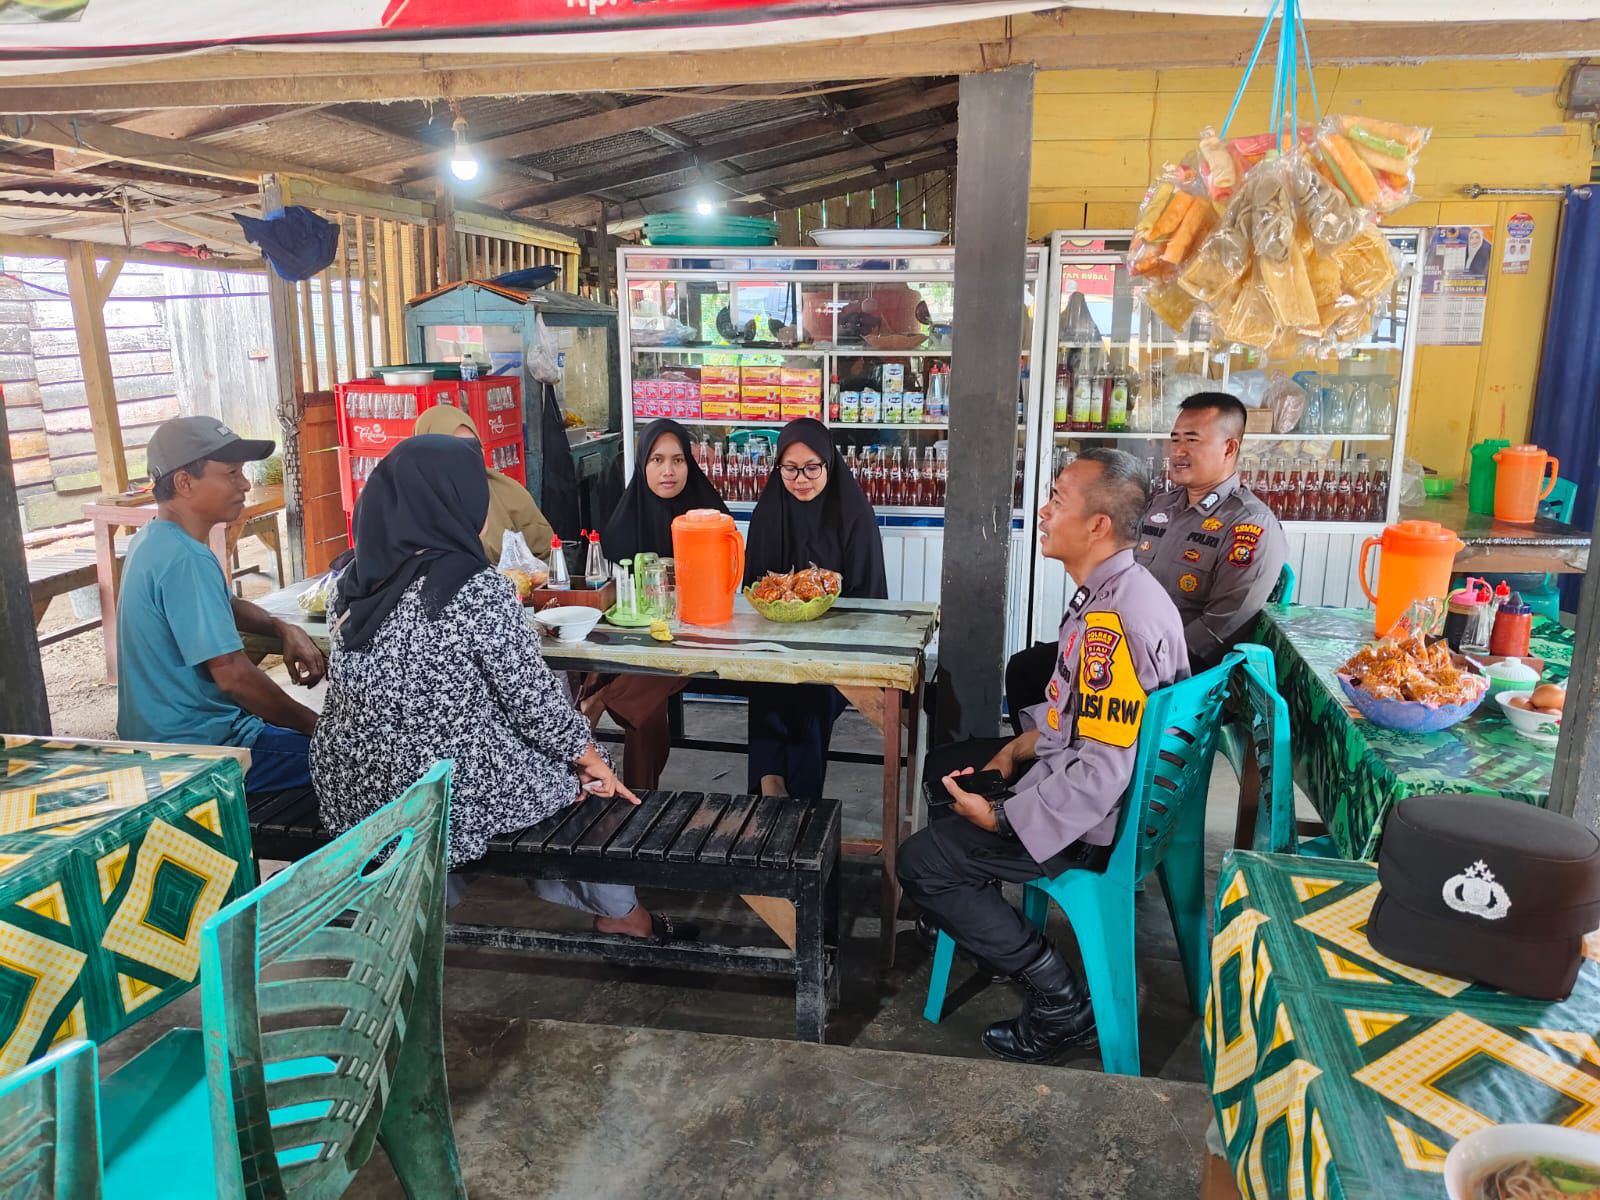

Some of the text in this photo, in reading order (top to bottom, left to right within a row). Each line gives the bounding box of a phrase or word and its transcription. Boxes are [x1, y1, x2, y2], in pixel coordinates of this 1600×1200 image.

[1187, 532, 1220, 548] POLRI
[1089, 645, 1108, 653] RIAU
[1107, 697, 1140, 725] RW
